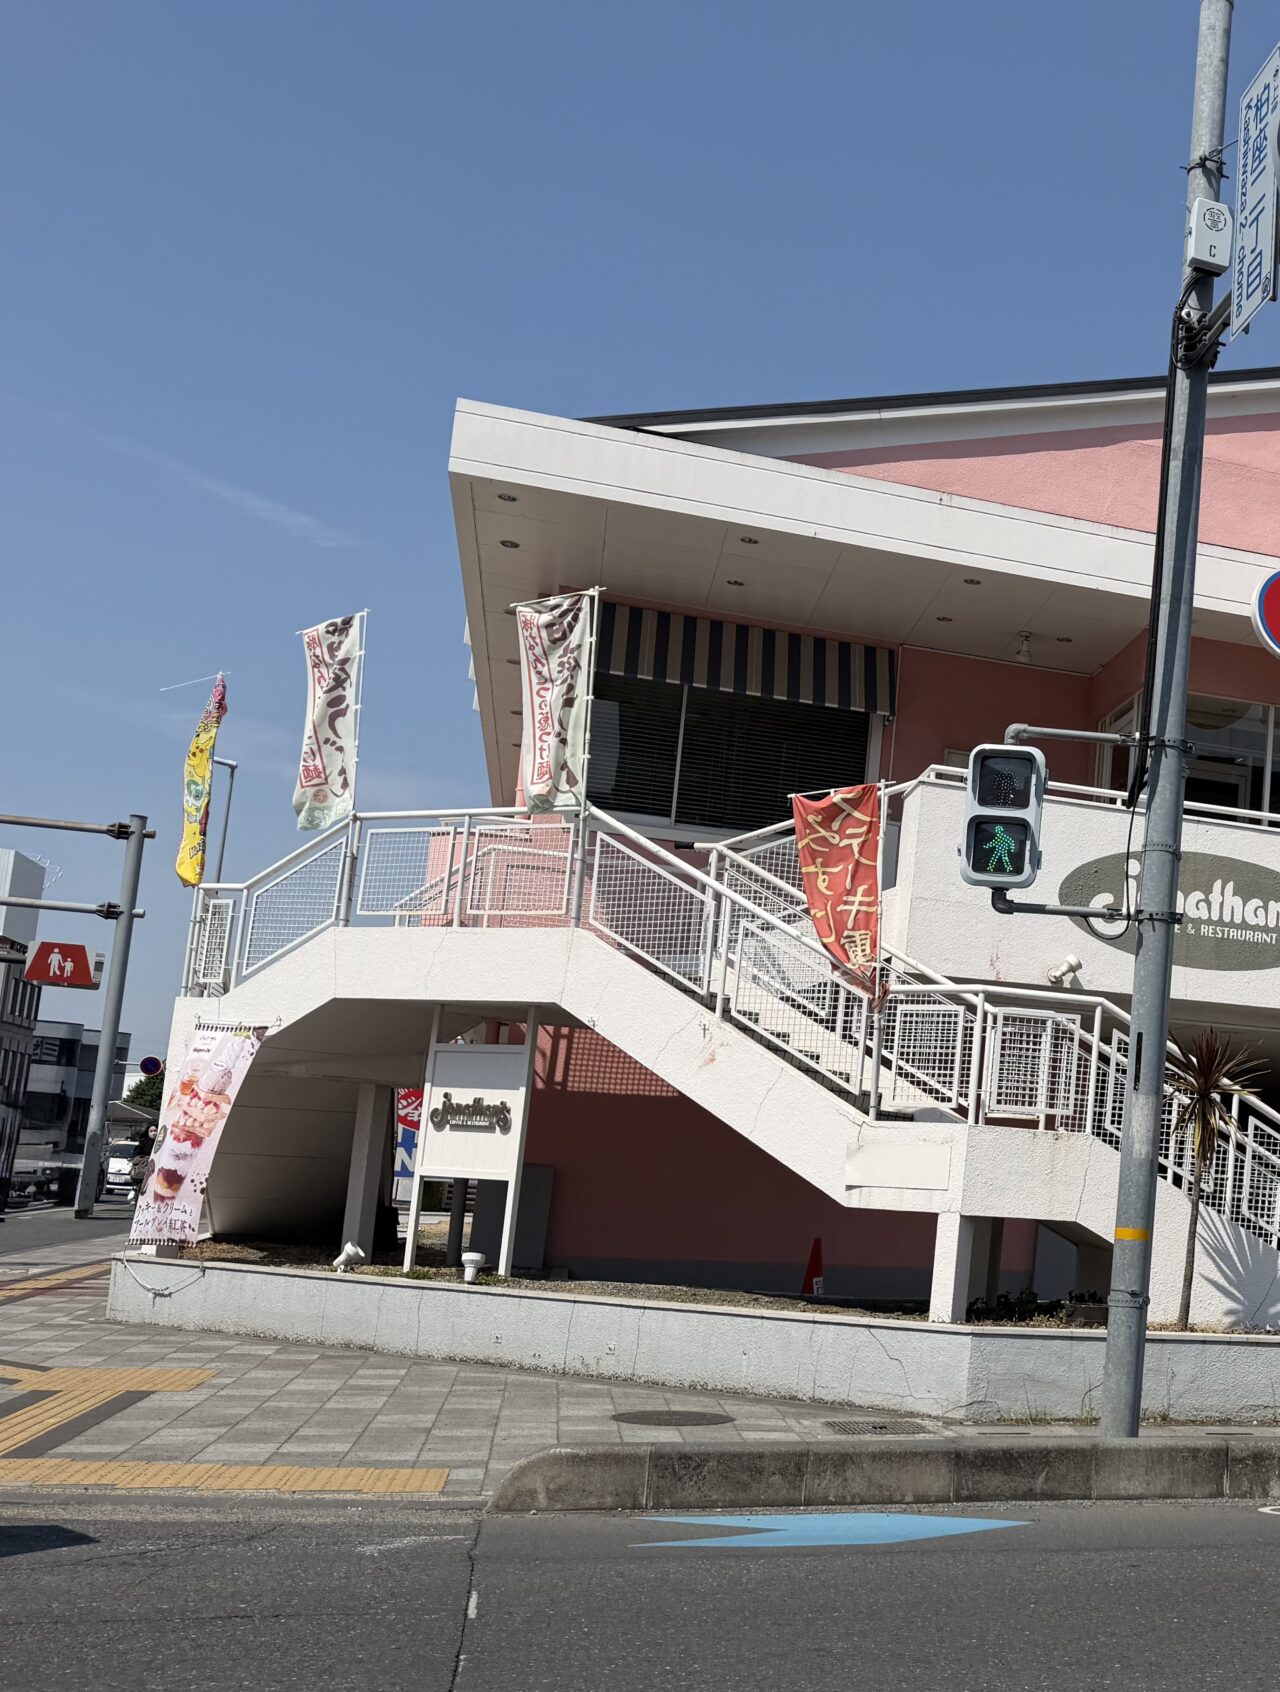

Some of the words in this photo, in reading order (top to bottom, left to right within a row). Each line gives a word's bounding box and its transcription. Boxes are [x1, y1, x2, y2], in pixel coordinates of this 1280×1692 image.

[1240, 97, 1253, 214] Kashiwaza
[1246, 82, 1271, 301] 柏座二丁目
[1209, 244, 1217, 258] C
[1186, 924, 1195, 935] &
[1200, 924, 1278, 945] RESTAURANT
